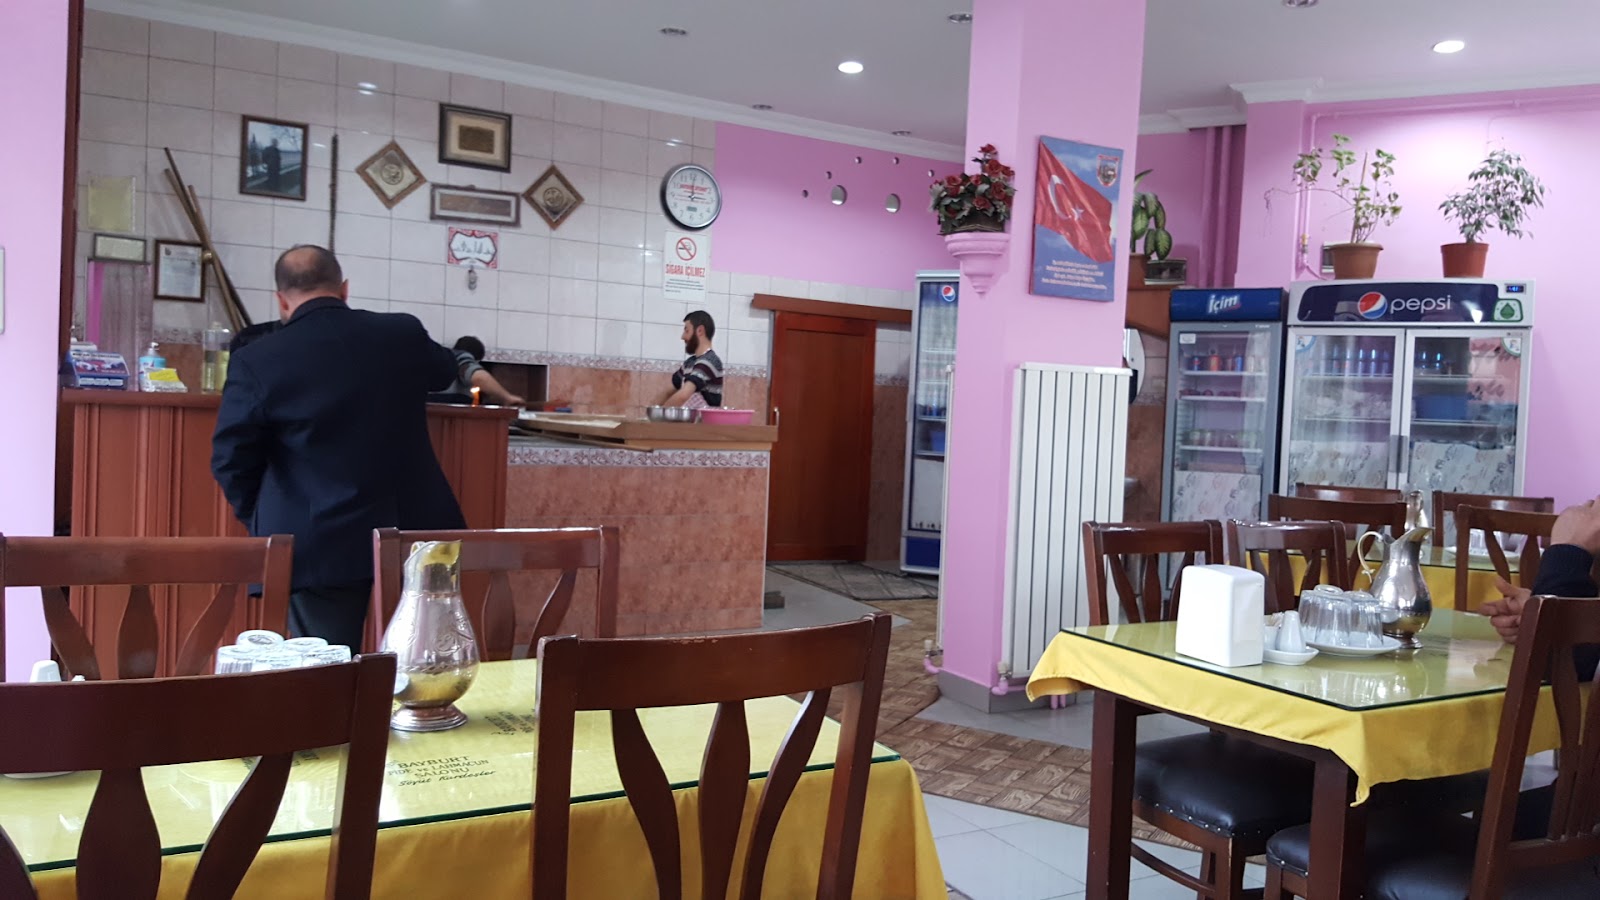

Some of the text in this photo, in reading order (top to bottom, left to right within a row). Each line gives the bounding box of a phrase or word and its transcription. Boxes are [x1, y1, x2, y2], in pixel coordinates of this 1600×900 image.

[1208, 294, 1240, 314] İçim
[1390, 294, 1452, 315] pepsi
[398, 756, 470, 769] BAYBURT
[431, 759, 489, 771] LAHMACUN
[414, 767, 470, 778] SALONU
